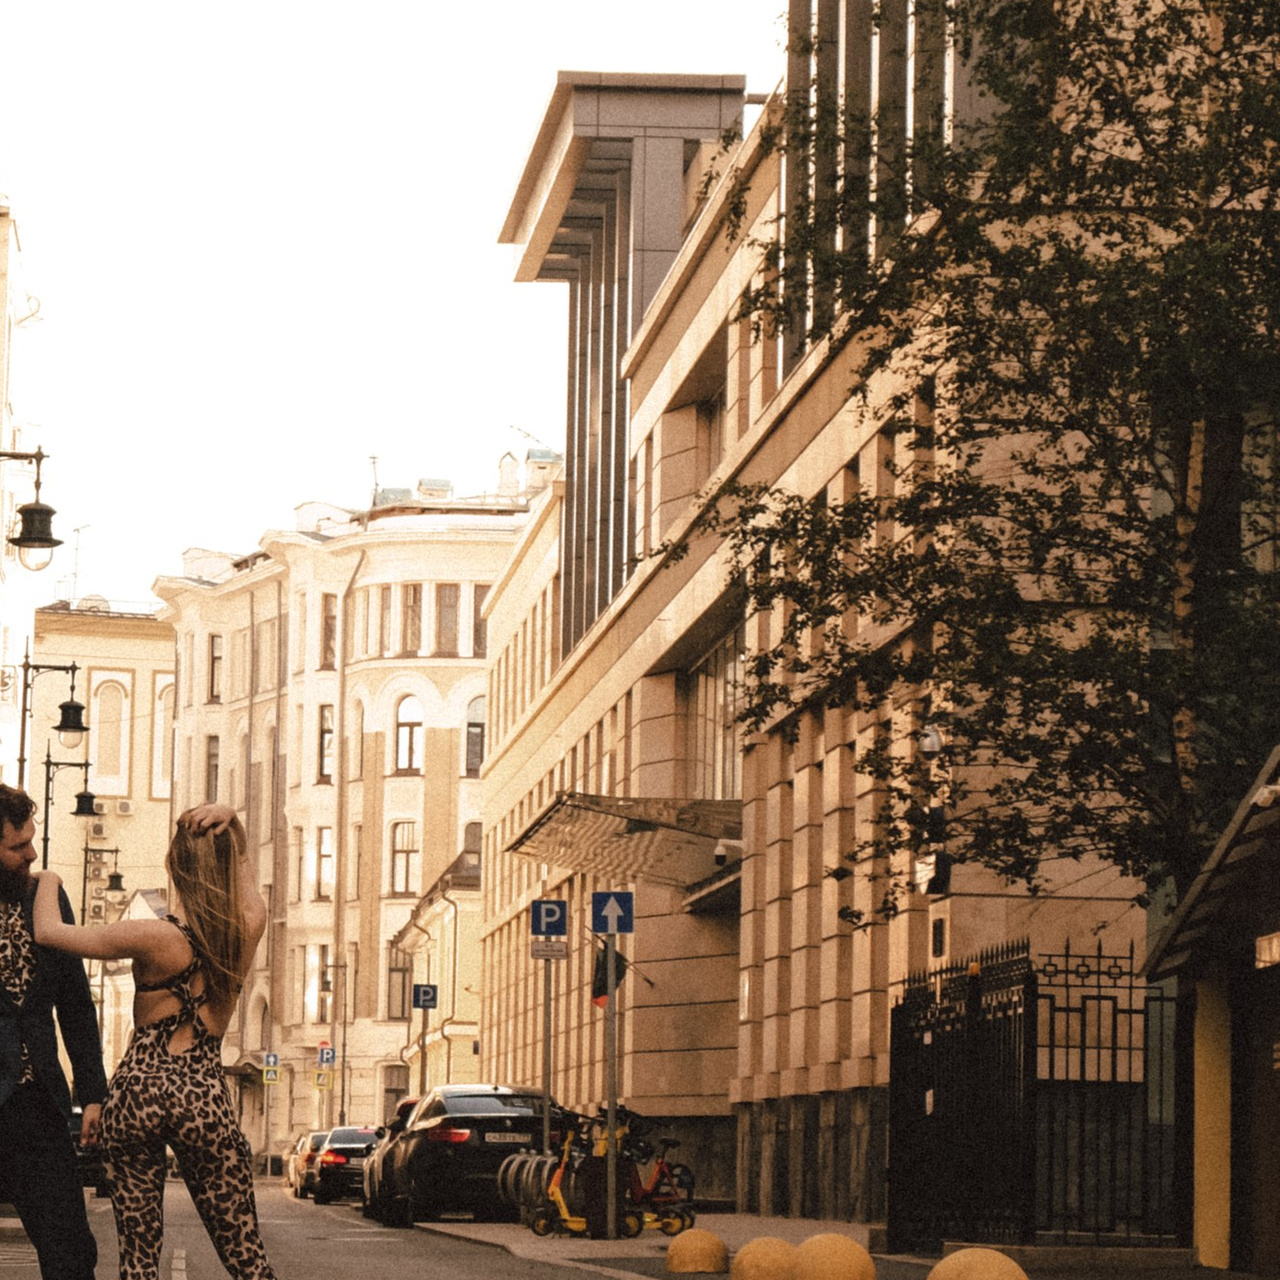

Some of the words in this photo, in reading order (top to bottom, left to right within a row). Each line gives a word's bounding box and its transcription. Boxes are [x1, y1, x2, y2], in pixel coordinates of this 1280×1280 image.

[541, 903, 561, 932] P
[419, 986, 434, 1006] P
[322, 1049, 333, 1062] P
